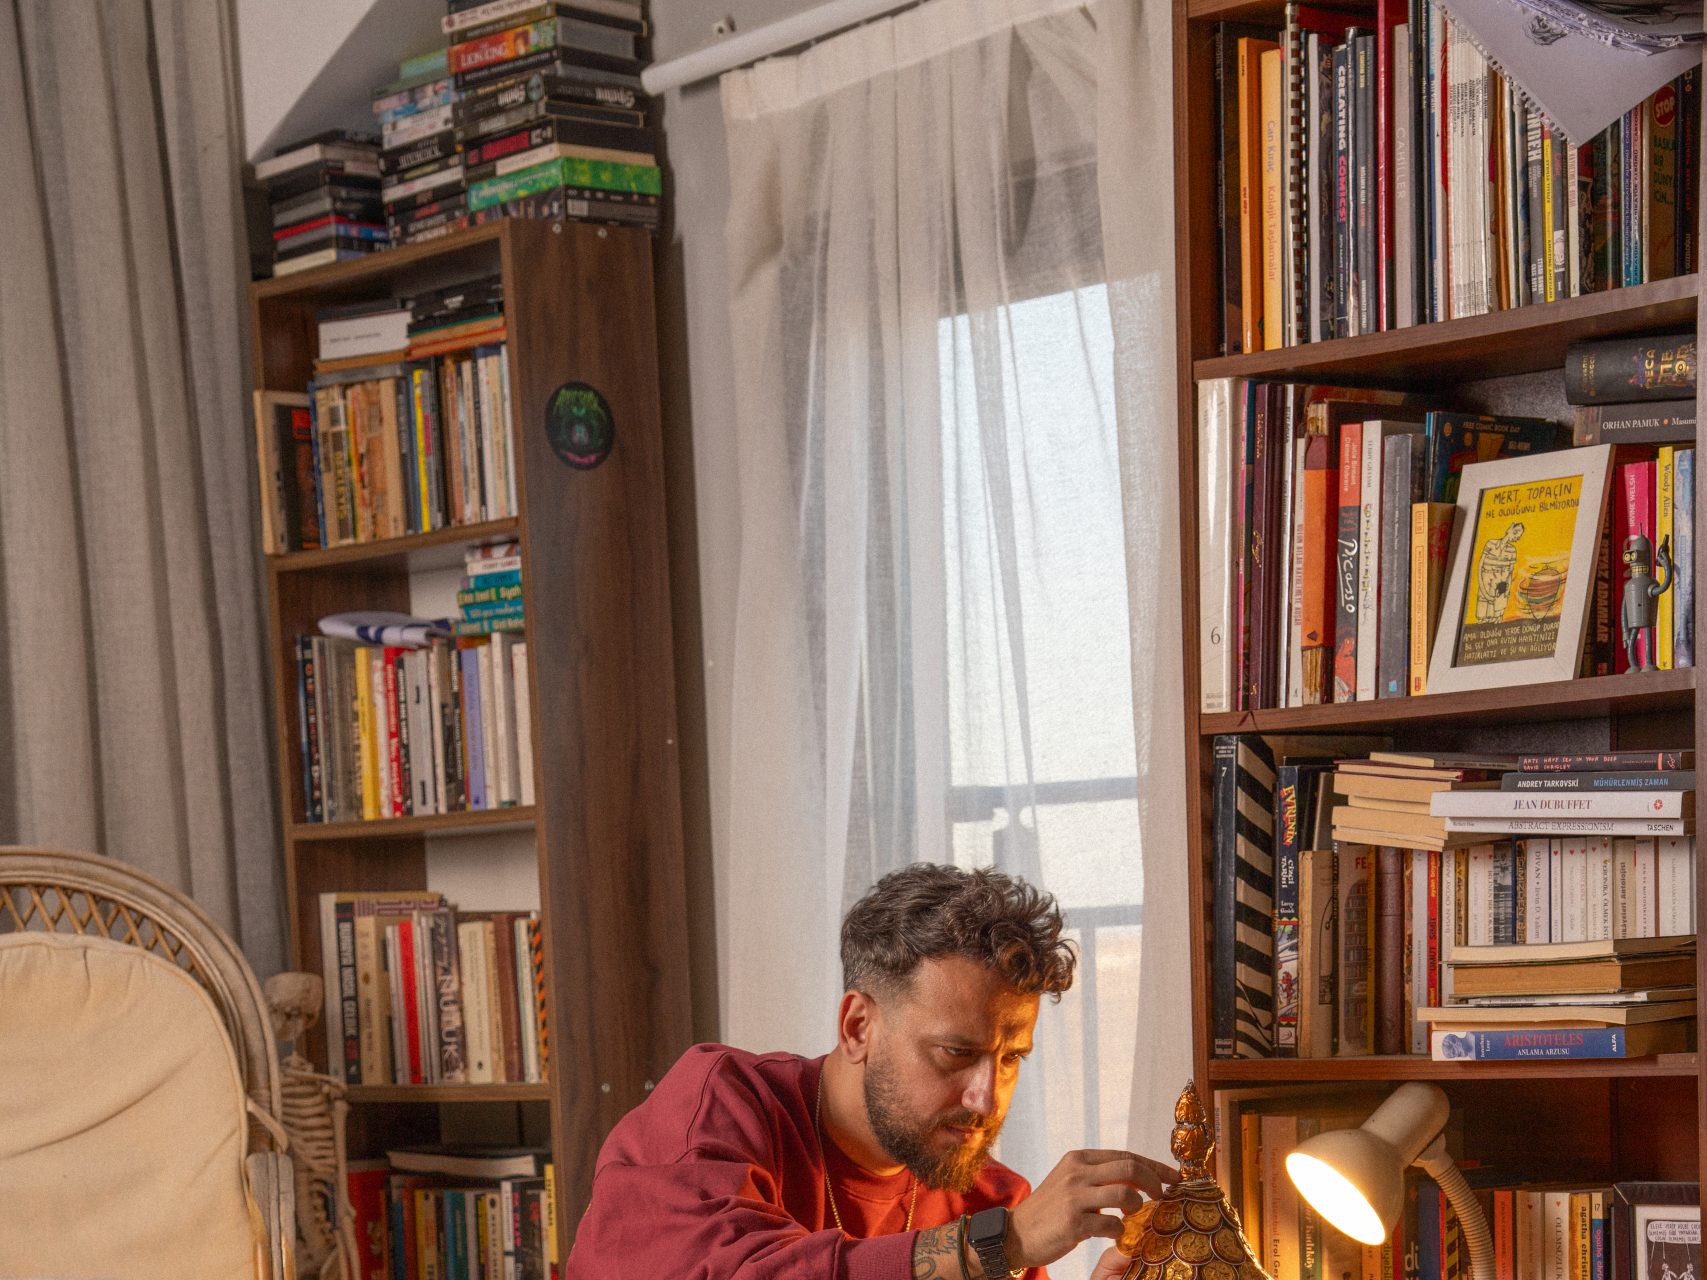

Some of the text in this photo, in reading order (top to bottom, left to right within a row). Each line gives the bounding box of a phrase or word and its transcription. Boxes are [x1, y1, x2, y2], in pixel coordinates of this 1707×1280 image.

[1267, 120, 1277, 142] Can
[1339, 66, 1347, 223] CREATING COMICS!
[1602, 420, 1631, 430] ORHAN
[1631, 419, 1660, 428] PAMUK
[1662, 464, 1671, 517] Woody Allen
[1486, 509, 1495, 519] NE
[1337, 538, 1358, 614] Picasso
[1596, 580, 1609, 642] ADAMLAR
[1211, 626, 1222, 645] 6
[1221, 766, 1228, 778] 7
[1517, 778, 1579, 788] ANDREY TARKOVSKİ
[1593, 777, 1669, 788] MÜHÜRLENMİŞ ZAMAN
[1513, 799, 1593, 810] JEAN DUBUFFET
[1508, 821, 1615, 832] ABSTRACT EXPRESSIONISM
[1647, 824, 1674, 832] TASCHEN
[1504, 1033, 1584, 1048] ARISTOTELES
[1545, 1048, 1570, 1056] ARZUSU
[1580, 1206, 1589, 1240] agatha
[1273, 1238, 1281, 1257] Erol
[1555, 1217, 1564, 1280] ÖLÜMSÜZLÜK
[1595, 1229, 1603, 1258] agatha
